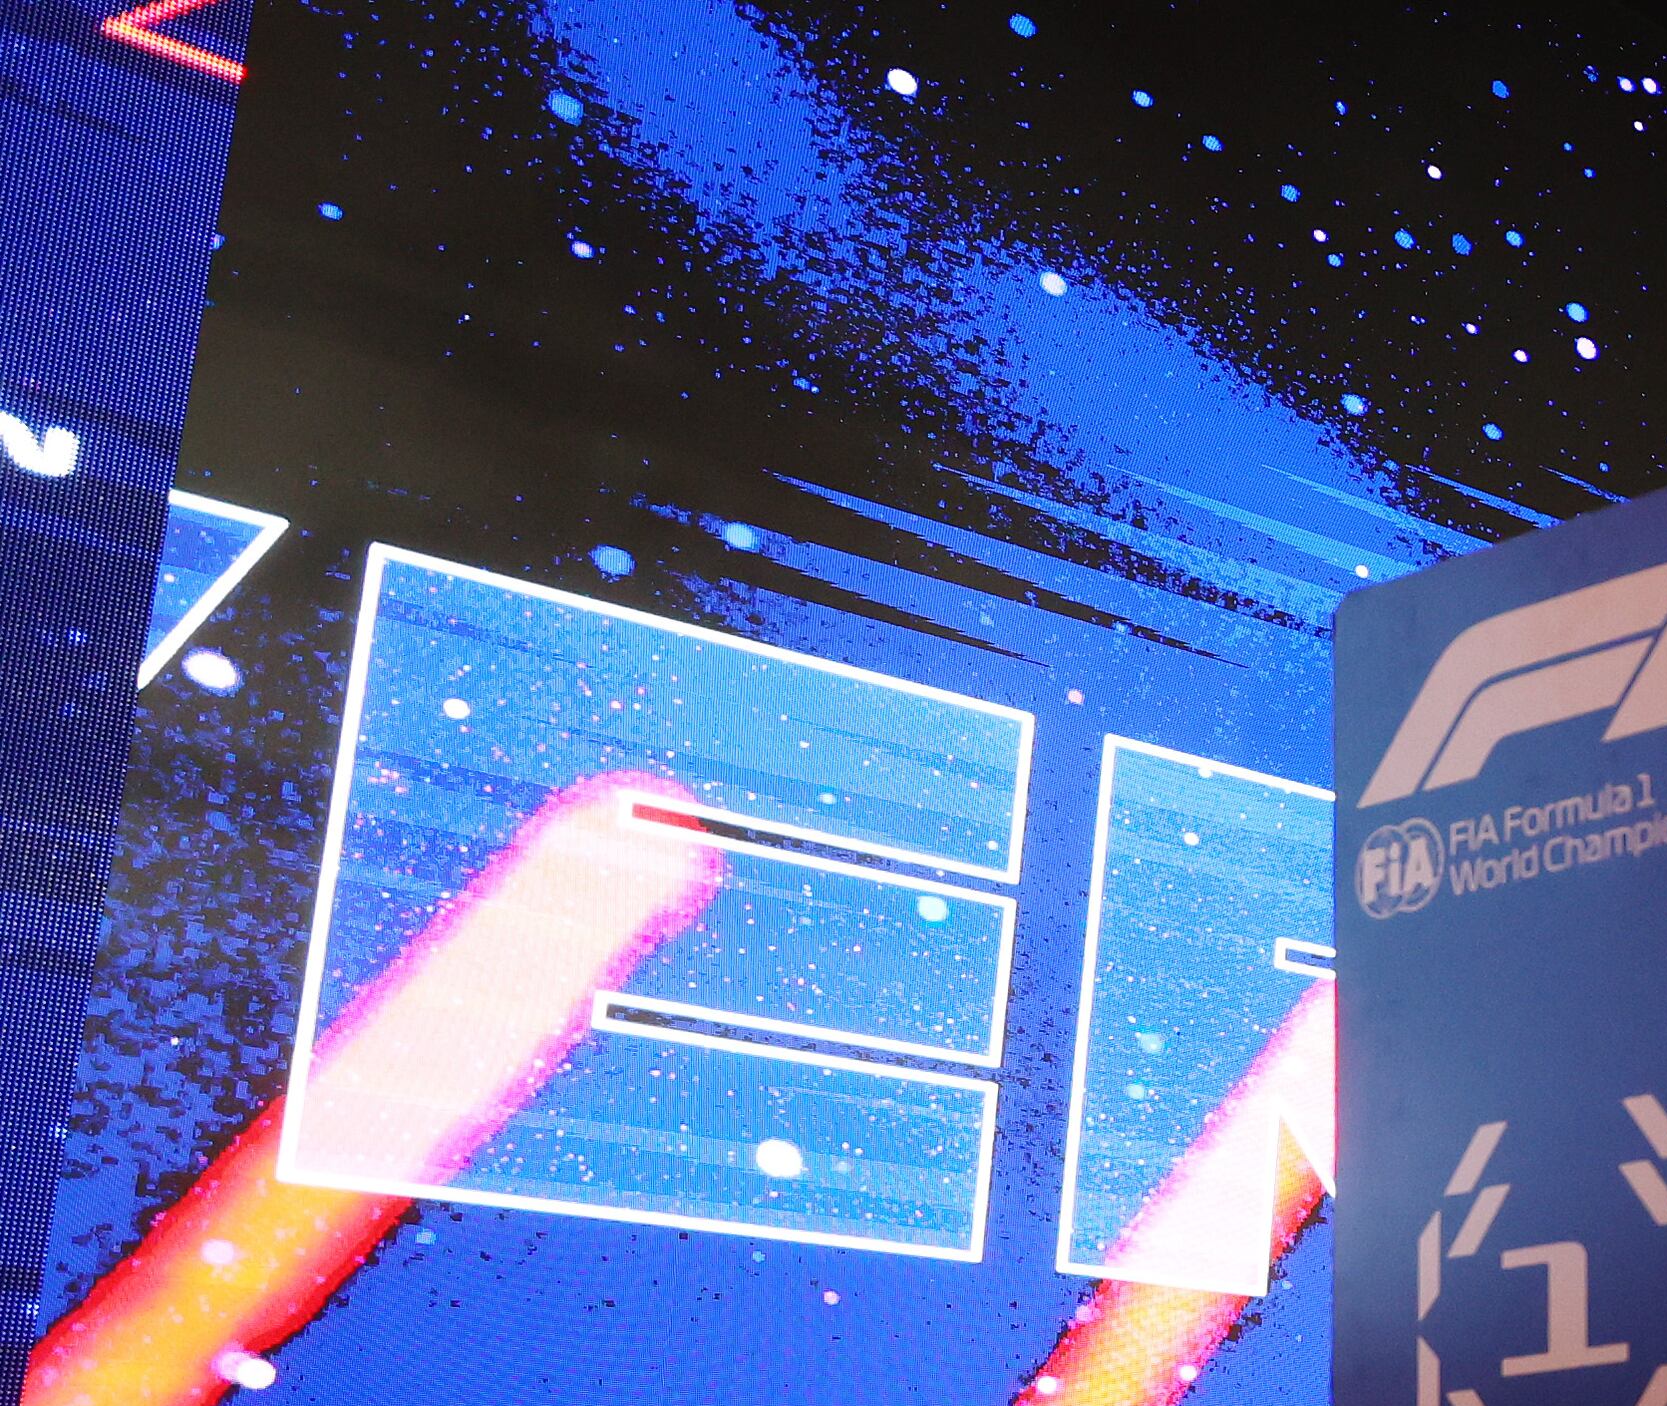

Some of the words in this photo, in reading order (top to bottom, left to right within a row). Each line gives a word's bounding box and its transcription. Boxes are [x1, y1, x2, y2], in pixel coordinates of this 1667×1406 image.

[1449, 814, 1499, 857] FIA
[1503, 783, 1633, 843] Formula
[1637, 773, 1655, 808] 1
[1448, 843, 1540, 898] World
[1501, 1240, 1629, 1378] 1
